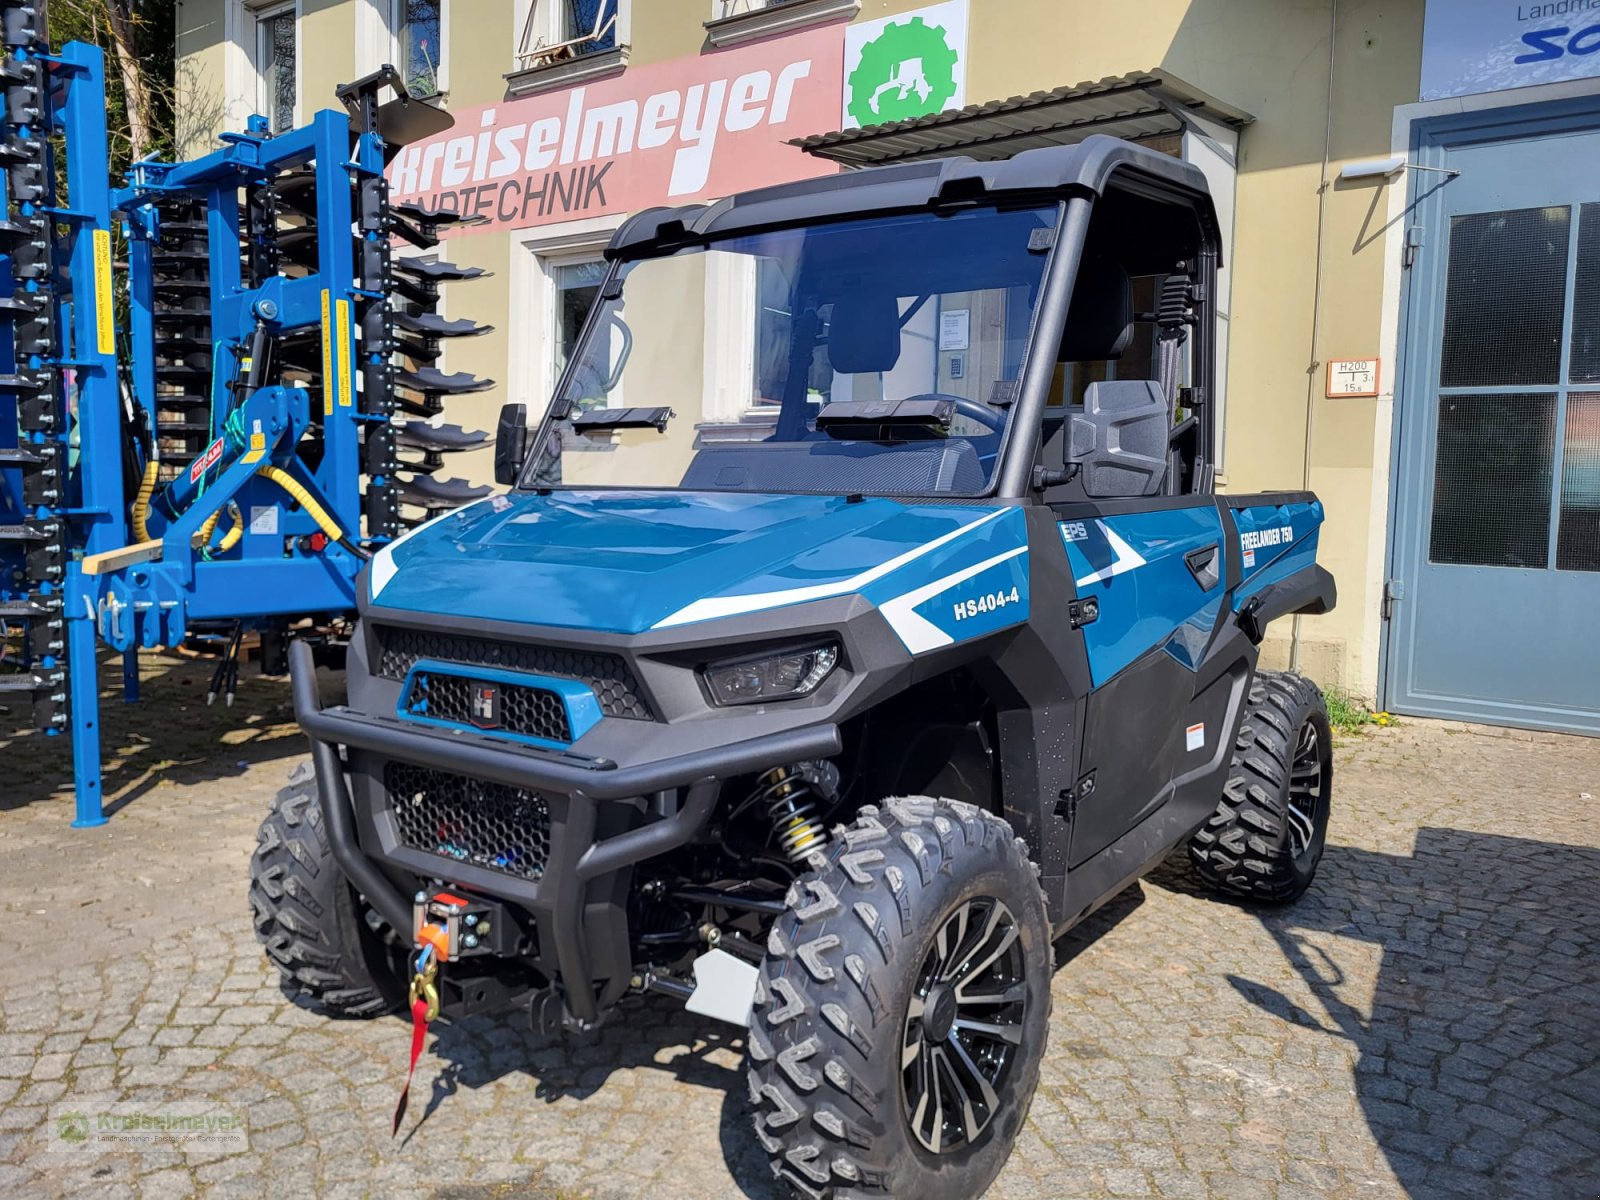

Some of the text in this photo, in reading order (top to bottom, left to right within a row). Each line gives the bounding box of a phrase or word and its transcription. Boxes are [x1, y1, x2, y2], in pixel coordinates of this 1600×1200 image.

[1340, 361, 1368, 371] H200
[1061, 522, 1088, 539] EPS
[1241, 525, 1293, 551] FREELANDER 750
[953, 587, 1019, 620] HS404-4
